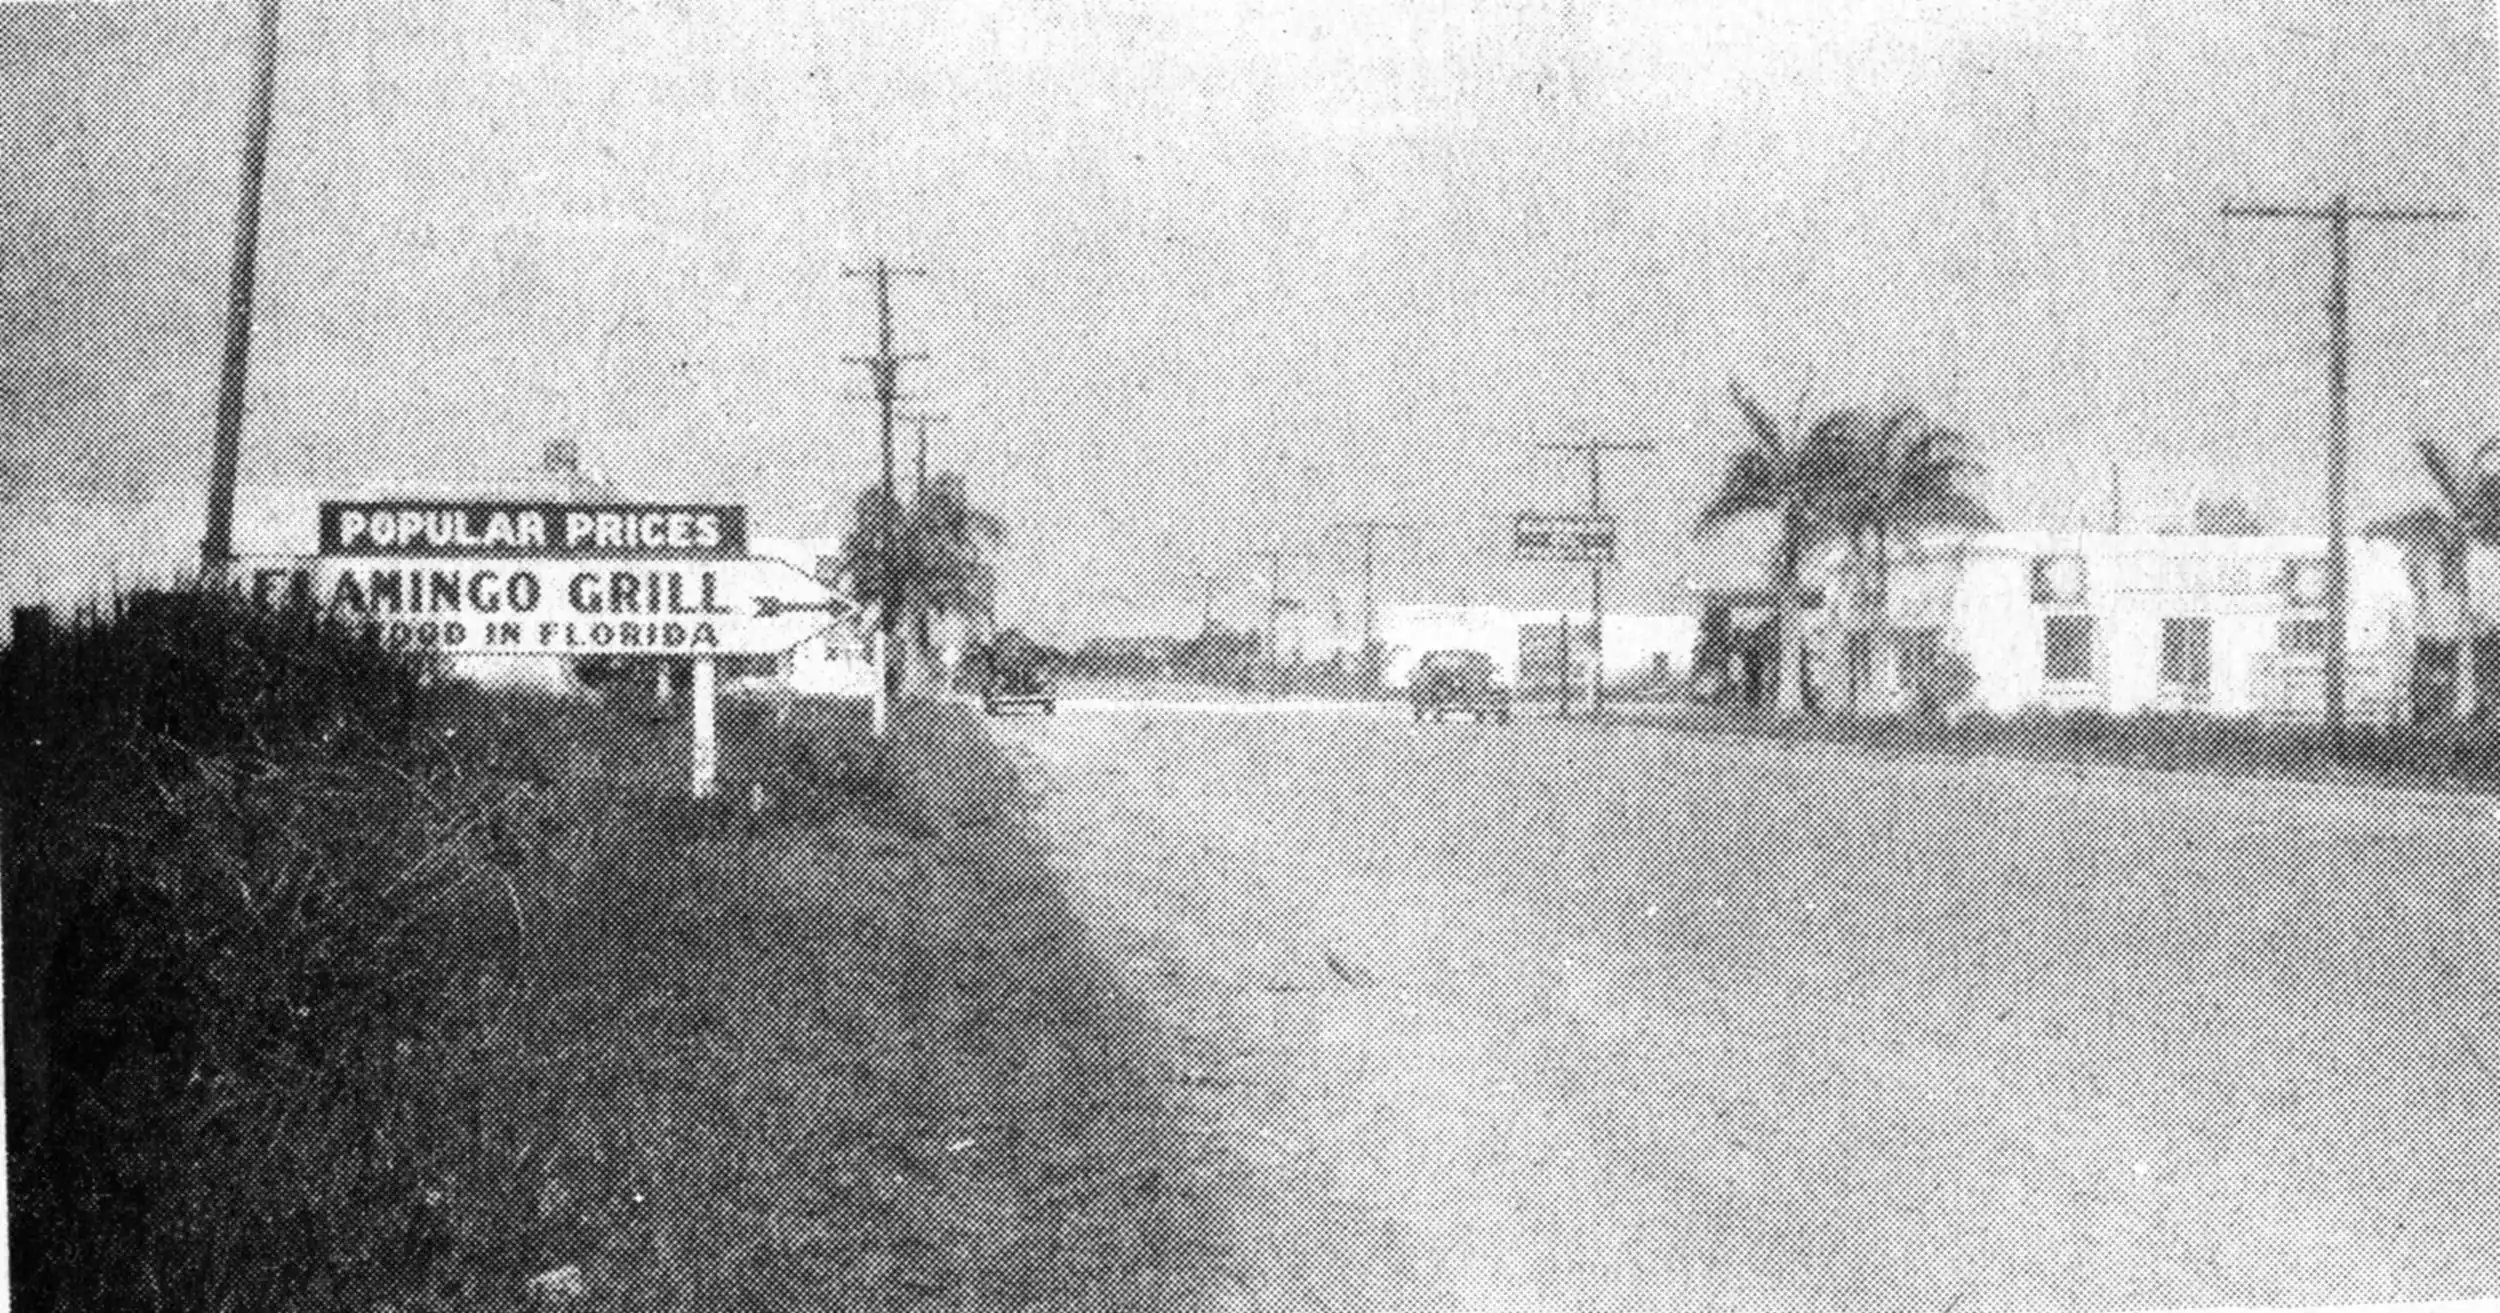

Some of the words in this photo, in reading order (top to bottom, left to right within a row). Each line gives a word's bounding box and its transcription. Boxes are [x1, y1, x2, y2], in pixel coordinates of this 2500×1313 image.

[340, 508, 547, 546] POPULAR
[566, 510, 721, 547] PRICES
[568, 571, 732, 615] GRILL
[485, 622, 521, 647] IN
[538, 621, 720, 648] FLORIDA
